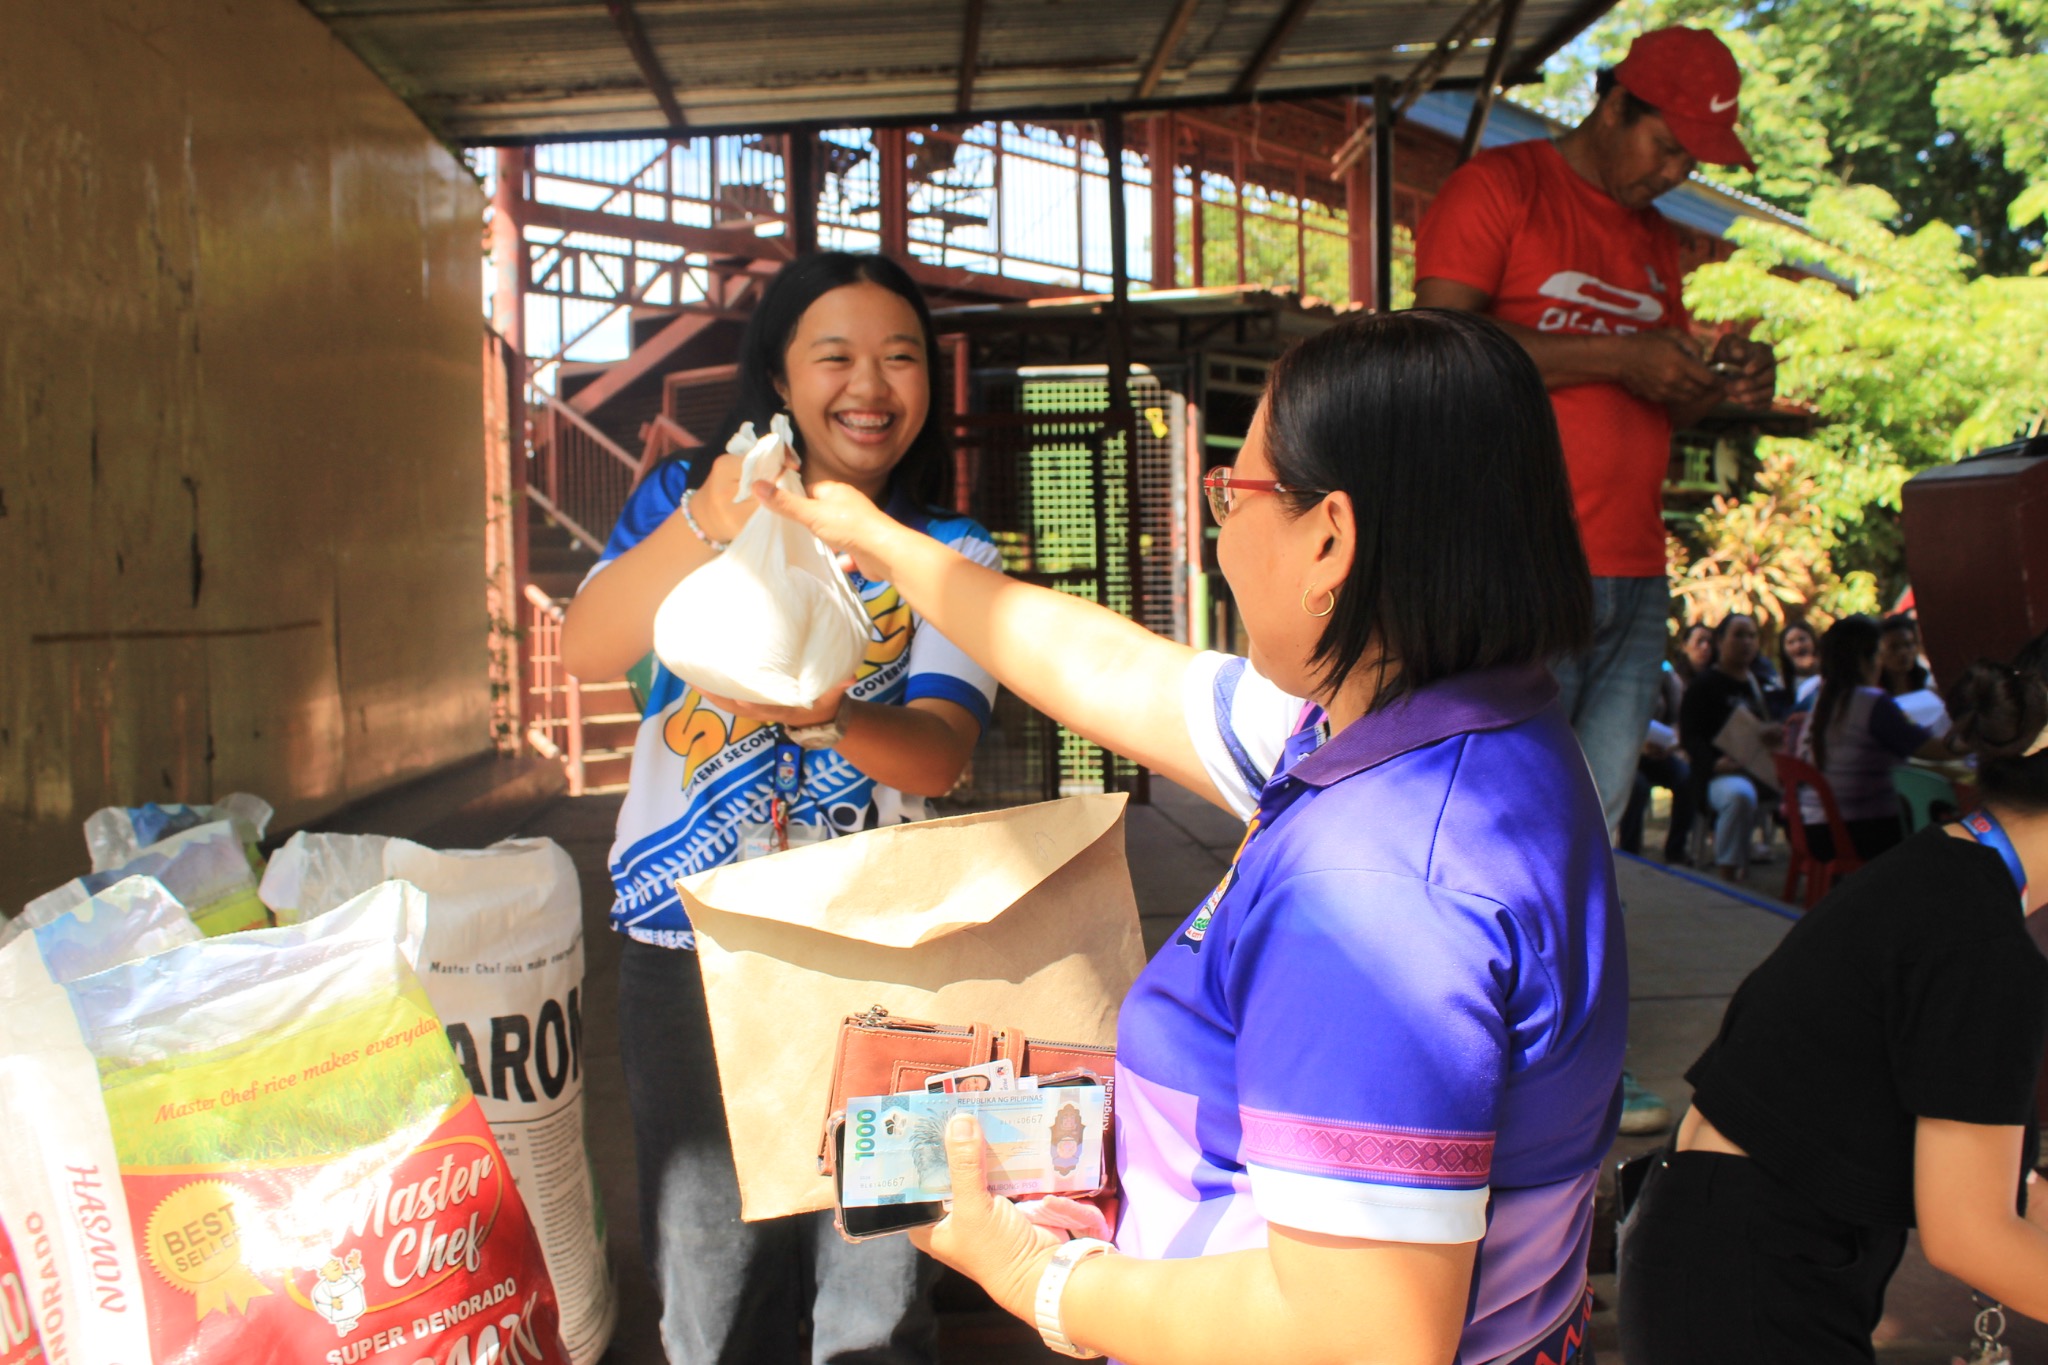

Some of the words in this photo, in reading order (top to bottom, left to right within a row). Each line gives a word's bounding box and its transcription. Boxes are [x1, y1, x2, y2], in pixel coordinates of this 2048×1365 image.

[429, 961, 470, 974] Master
[154, 1098, 216, 1124] Master
[221, 1081, 258, 1107] Chef
[264, 1072, 297, 1095] rice
[303, 1051, 359, 1081] makes
[957, 1096, 996, 1105] REPUBLIKA
[1010, 1094, 1043, 1103] PILIPINAS
[855, 1109, 877, 1161] 1000
[338, 1153, 494, 1239] Master
[163, 1202, 236, 1256] BEST
[383, 1211, 484, 1288] Chef
[326, 1326, 408, 1365] SUPER
[412, 1277, 517, 1340] DENORADO
